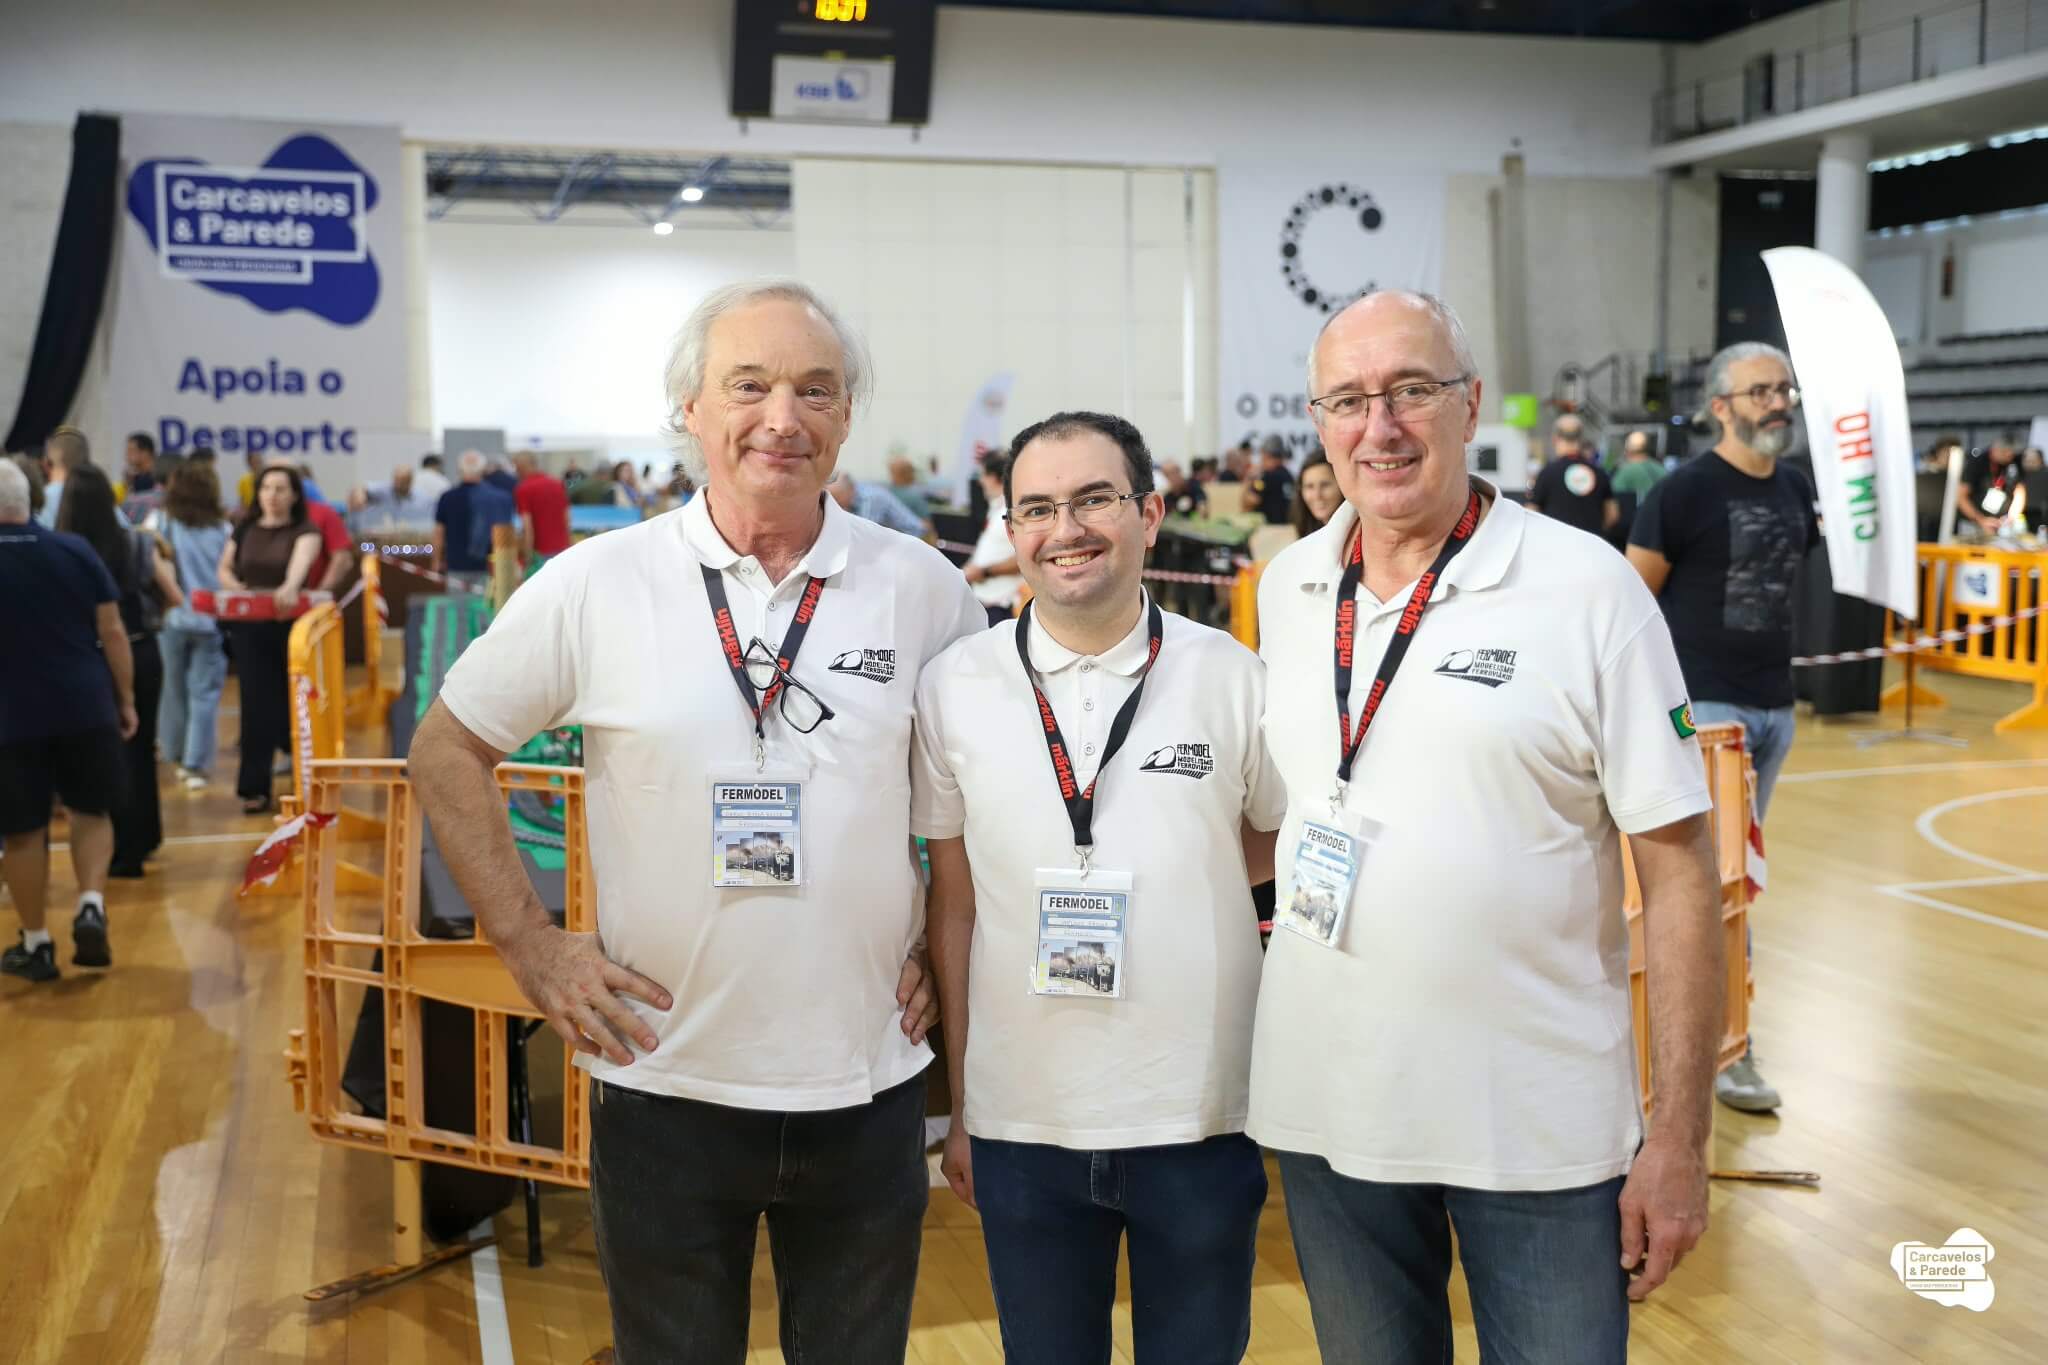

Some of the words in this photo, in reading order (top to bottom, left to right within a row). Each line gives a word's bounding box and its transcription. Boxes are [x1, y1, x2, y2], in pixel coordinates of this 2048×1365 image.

[171, 178, 351, 218] Carcavelos
[173, 217, 193, 242] &
[199, 212, 315, 247] Parede
[177, 358, 306, 402] Apoia
[318, 369, 344, 395] o
[1236, 393, 1259, 419] O
[1846, 472, 1879, 543] CIM
[1338, 599, 1354, 668] märklin
[1177, 743, 1213, 758] FERMODEL
[1051, 742, 1076, 800] märklin
[722, 788, 784, 801] FERMODEL
[1306, 828, 1348, 853] FERMODEL
[1049, 896, 1109, 911] FERMODEL
